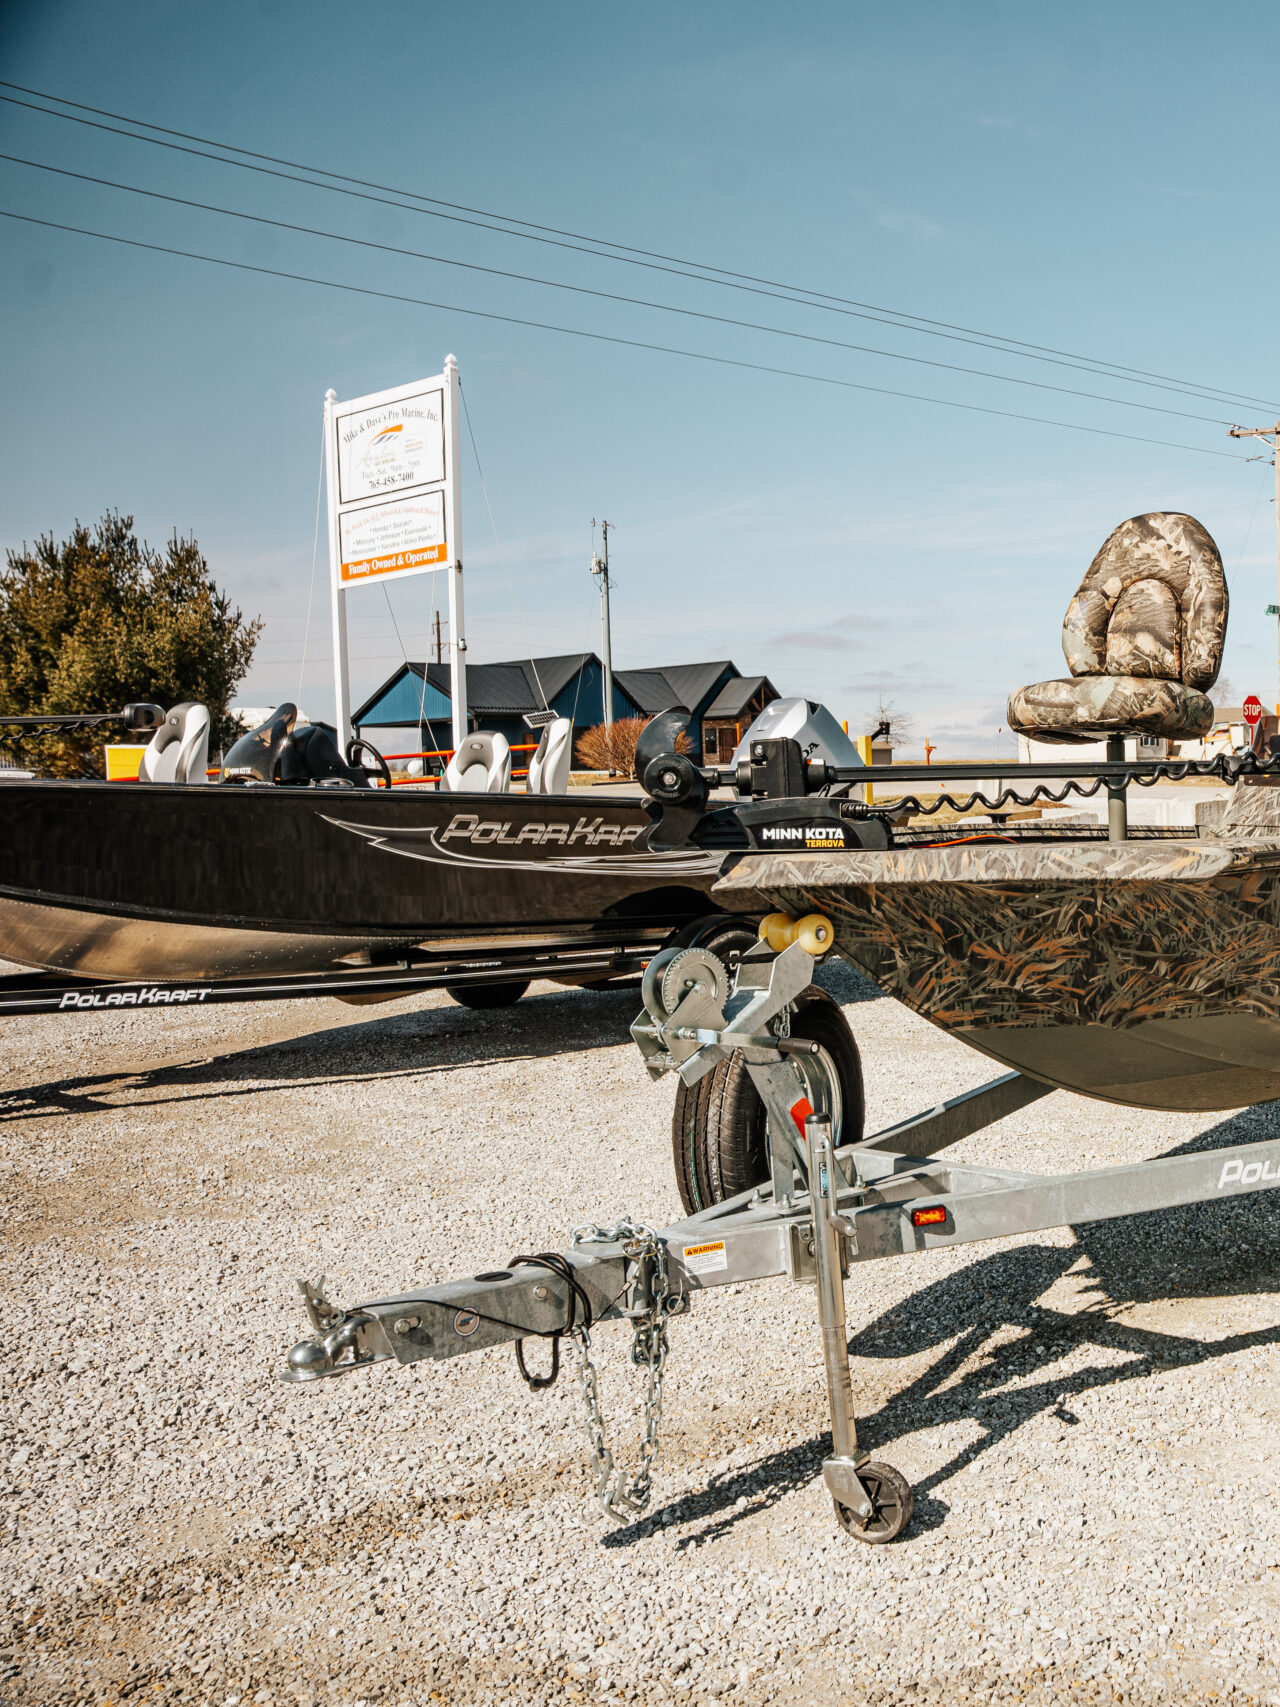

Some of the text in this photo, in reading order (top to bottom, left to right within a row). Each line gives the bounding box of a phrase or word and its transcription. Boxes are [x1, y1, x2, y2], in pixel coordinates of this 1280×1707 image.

[343, 430, 358, 443] Mike
[359, 422, 366, 433] &
[366, 411, 387, 429] Dave's
[388, 409, 400, 420] Pro
[427, 409, 439, 421] Inc.
[404, 537, 417, 545] Volvo
[349, 548, 439, 575] Family Owned & Operated
[1243, 704, 1261, 716] STOP
[439, 814, 645, 846] POLARKRA
[762, 828, 845, 840] MINN KOTA
[805, 839, 845, 848] TERROVA
[693, 1243, 724, 1254] WARNING
